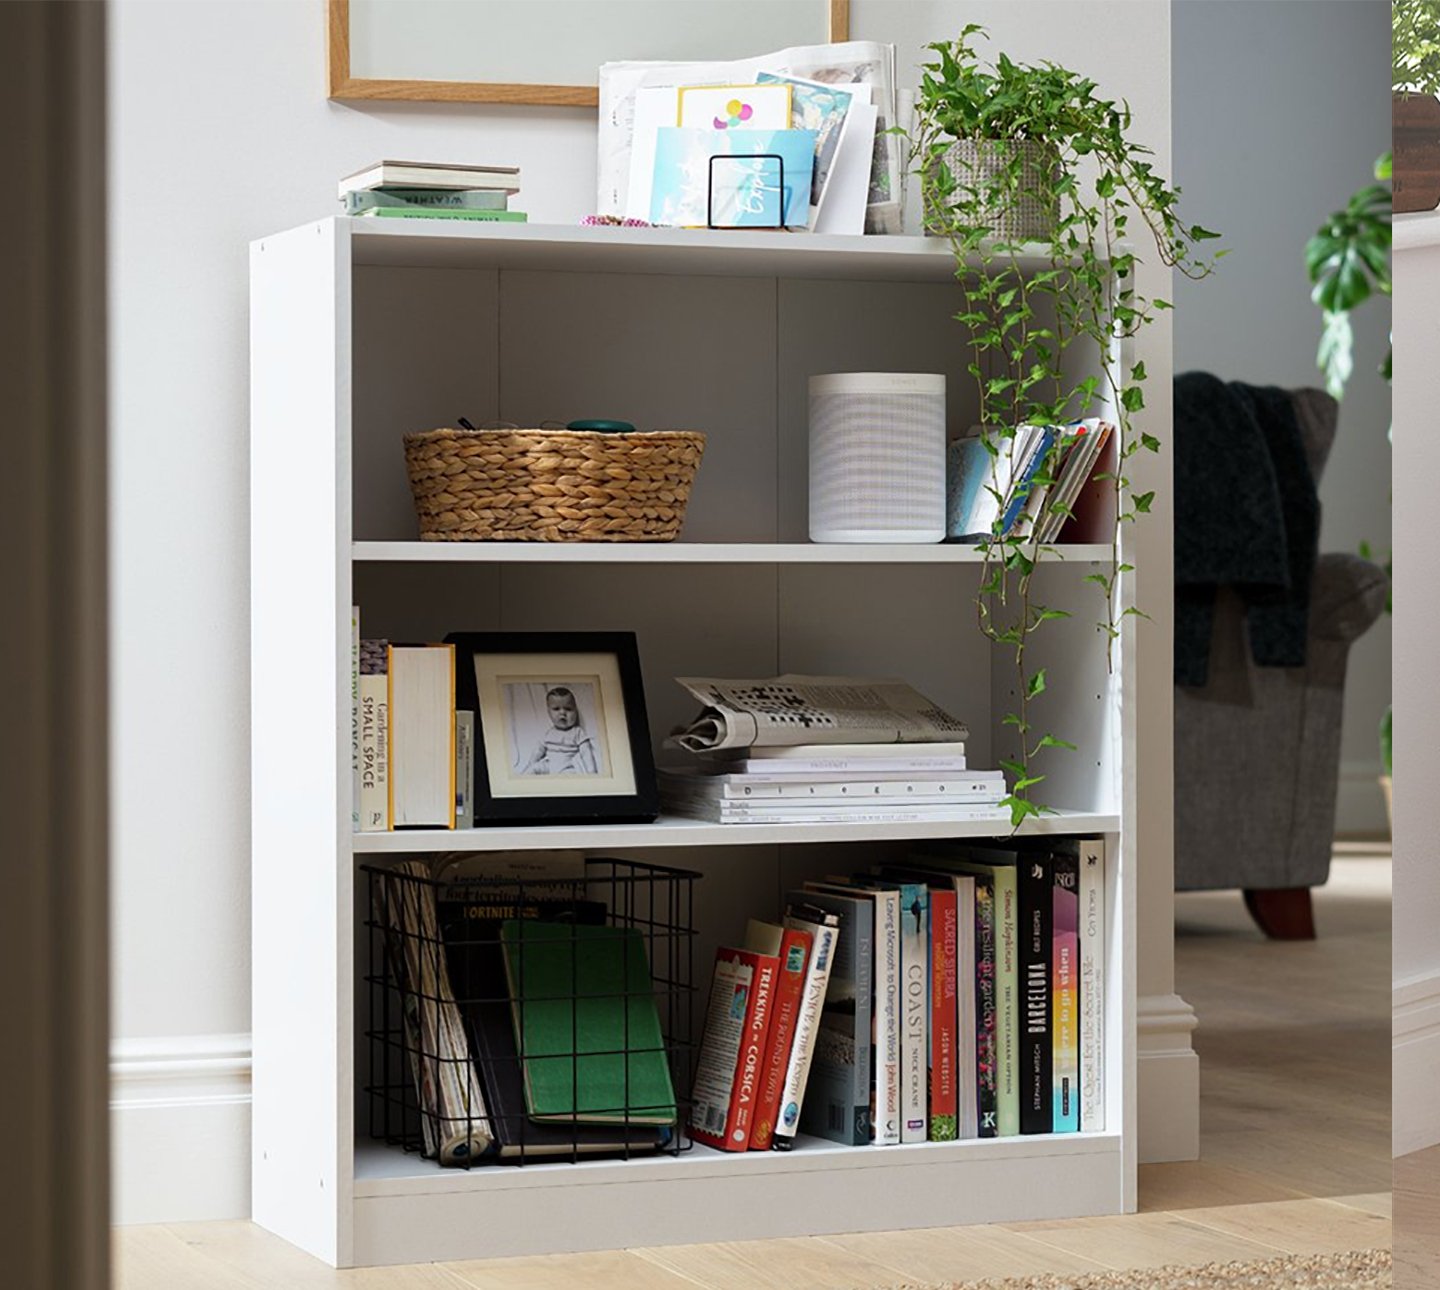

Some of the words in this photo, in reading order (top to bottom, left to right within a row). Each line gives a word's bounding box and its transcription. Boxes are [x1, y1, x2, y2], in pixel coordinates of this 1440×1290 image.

[362, 696, 374, 741] SMALL
[376, 702, 388, 761] Gardening
[362, 745, 375, 790] SPACE
[377, 762, 386, 773] in
[884, 897, 896, 930] Leaving
[1004, 889, 1013, 920] Simon
[945, 908, 956, 953] SACRED
[1002, 922, 1014, 974] Hopkinson
[885, 930, 896, 971] Microsoft
[1058, 947, 1069, 985] when
[886, 973, 896, 983] to
[945, 956, 956, 999] SIERRA
[752, 967, 772, 1031] TREKKING
[780, 1001, 792, 1021] THE
[805, 973, 826, 1024] VENICE
[885, 984, 896, 1018] Change
[908, 964, 922, 1042] COAST
[980, 980, 994, 1027] garden
[1027, 962, 1047, 1034] BARCELONA
[1059, 1008, 1069, 1022] to
[1060, 988, 1072, 1006] go
[1083, 979, 1094, 1018] Secret
[772, 1022, 789, 1064] ROUND
[886, 1019, 896, 1033] the
[941, 1027, 950, 1055] JASON
[1083, 1021, 1094, 1039] the
[886, 1034, 896, 1062] World
[911, 1048, 919, 1072] NICK
[1083, 1042, 1094, 1058] for
[739, 1044, 758, 1104] CORSICA
[763, 1067, 780, 1104] TOWER
[790, 1052, 807, 1097] VENETO
[885, 1063, 897, 1086] John
[911, 1074, 919, 1109] CRANE
[941, 1057, 950, 1096] WEBSTER
[1083, 1063, 1096, 1097] Quest
[886, 1086, 896, 1113] Wood
[1033, 1075, 1041, 1111] STEPHAN
[1084, 1098, 1095, 1121] The
